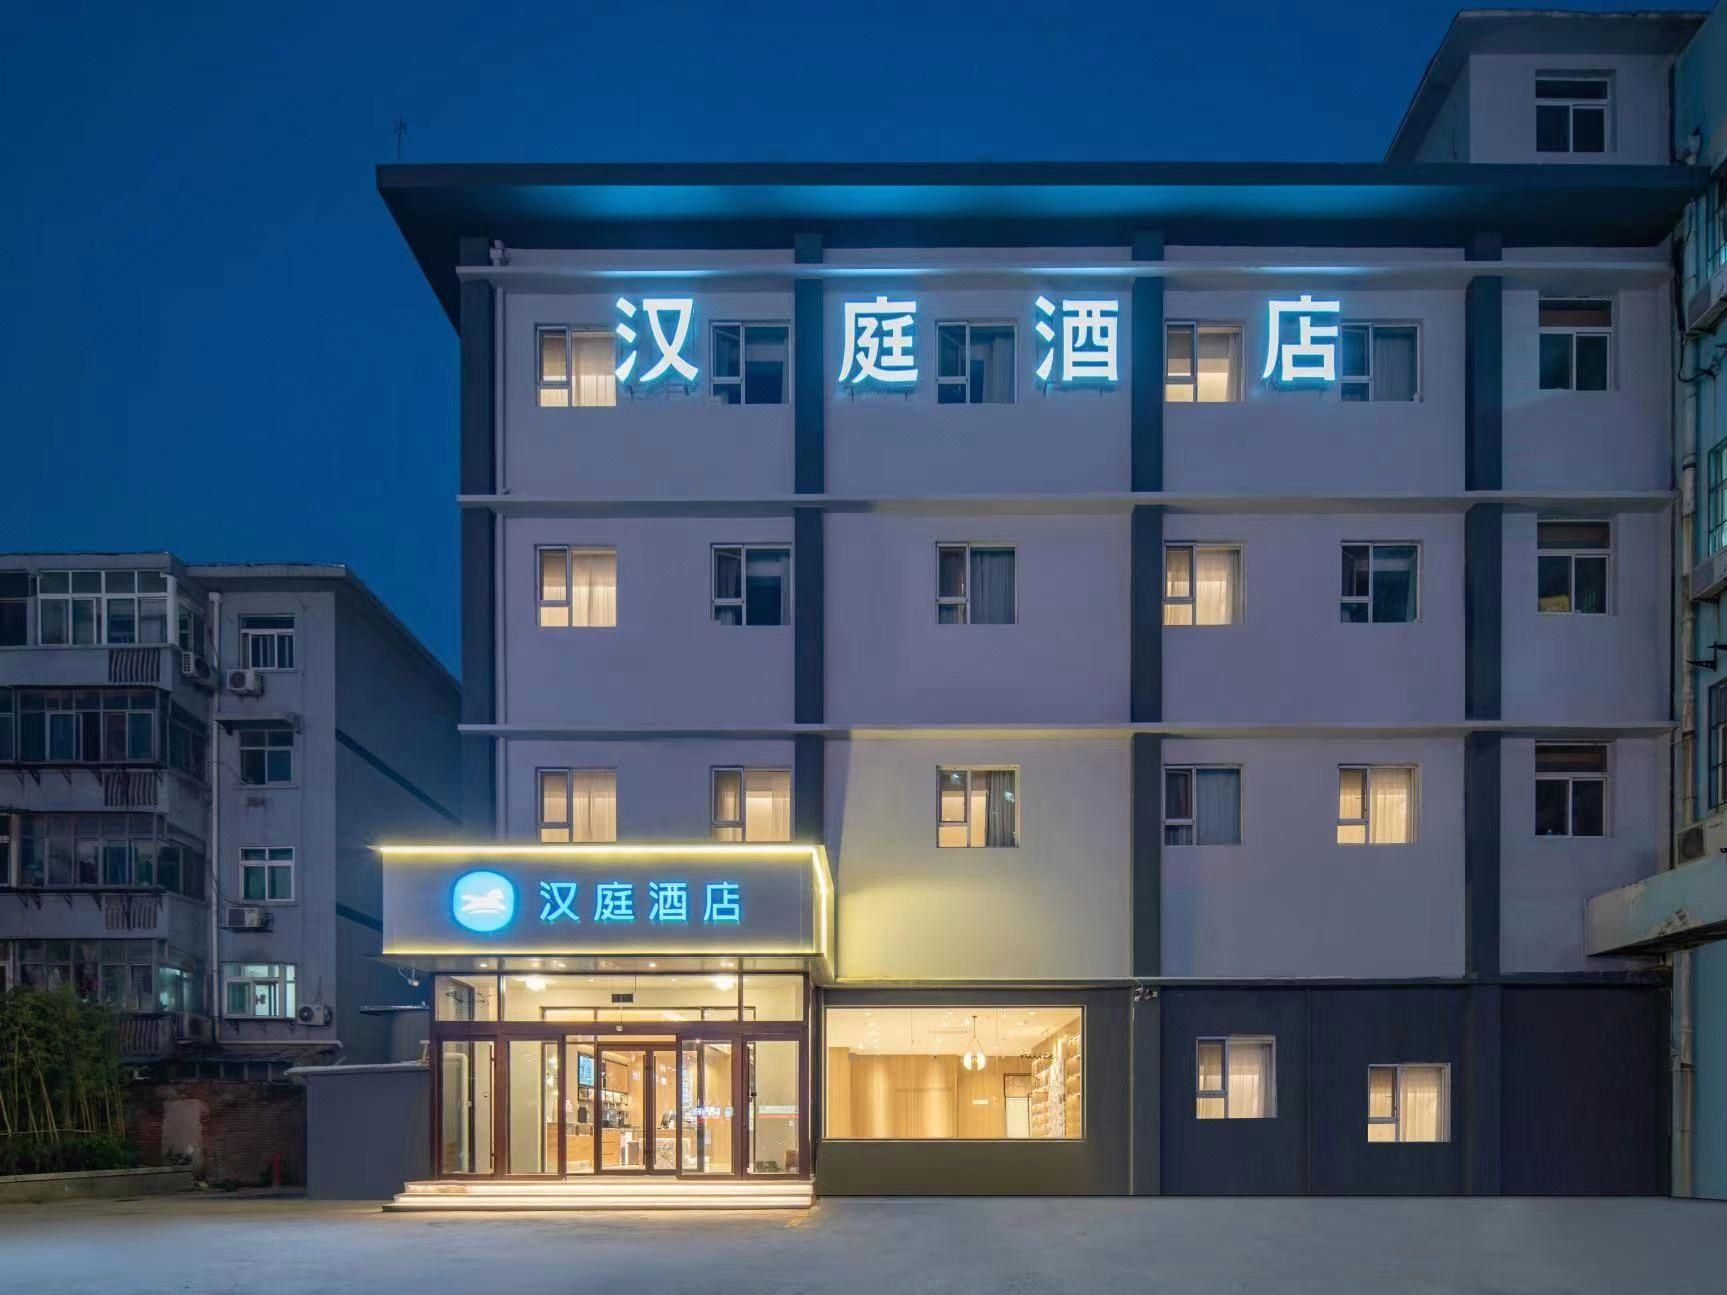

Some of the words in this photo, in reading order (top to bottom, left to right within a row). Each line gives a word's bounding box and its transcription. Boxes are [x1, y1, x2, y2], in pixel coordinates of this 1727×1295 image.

[615, 295, 1341, 383] 汉庭酒店
[539, 881, 740, 921] 汉庭酒店
